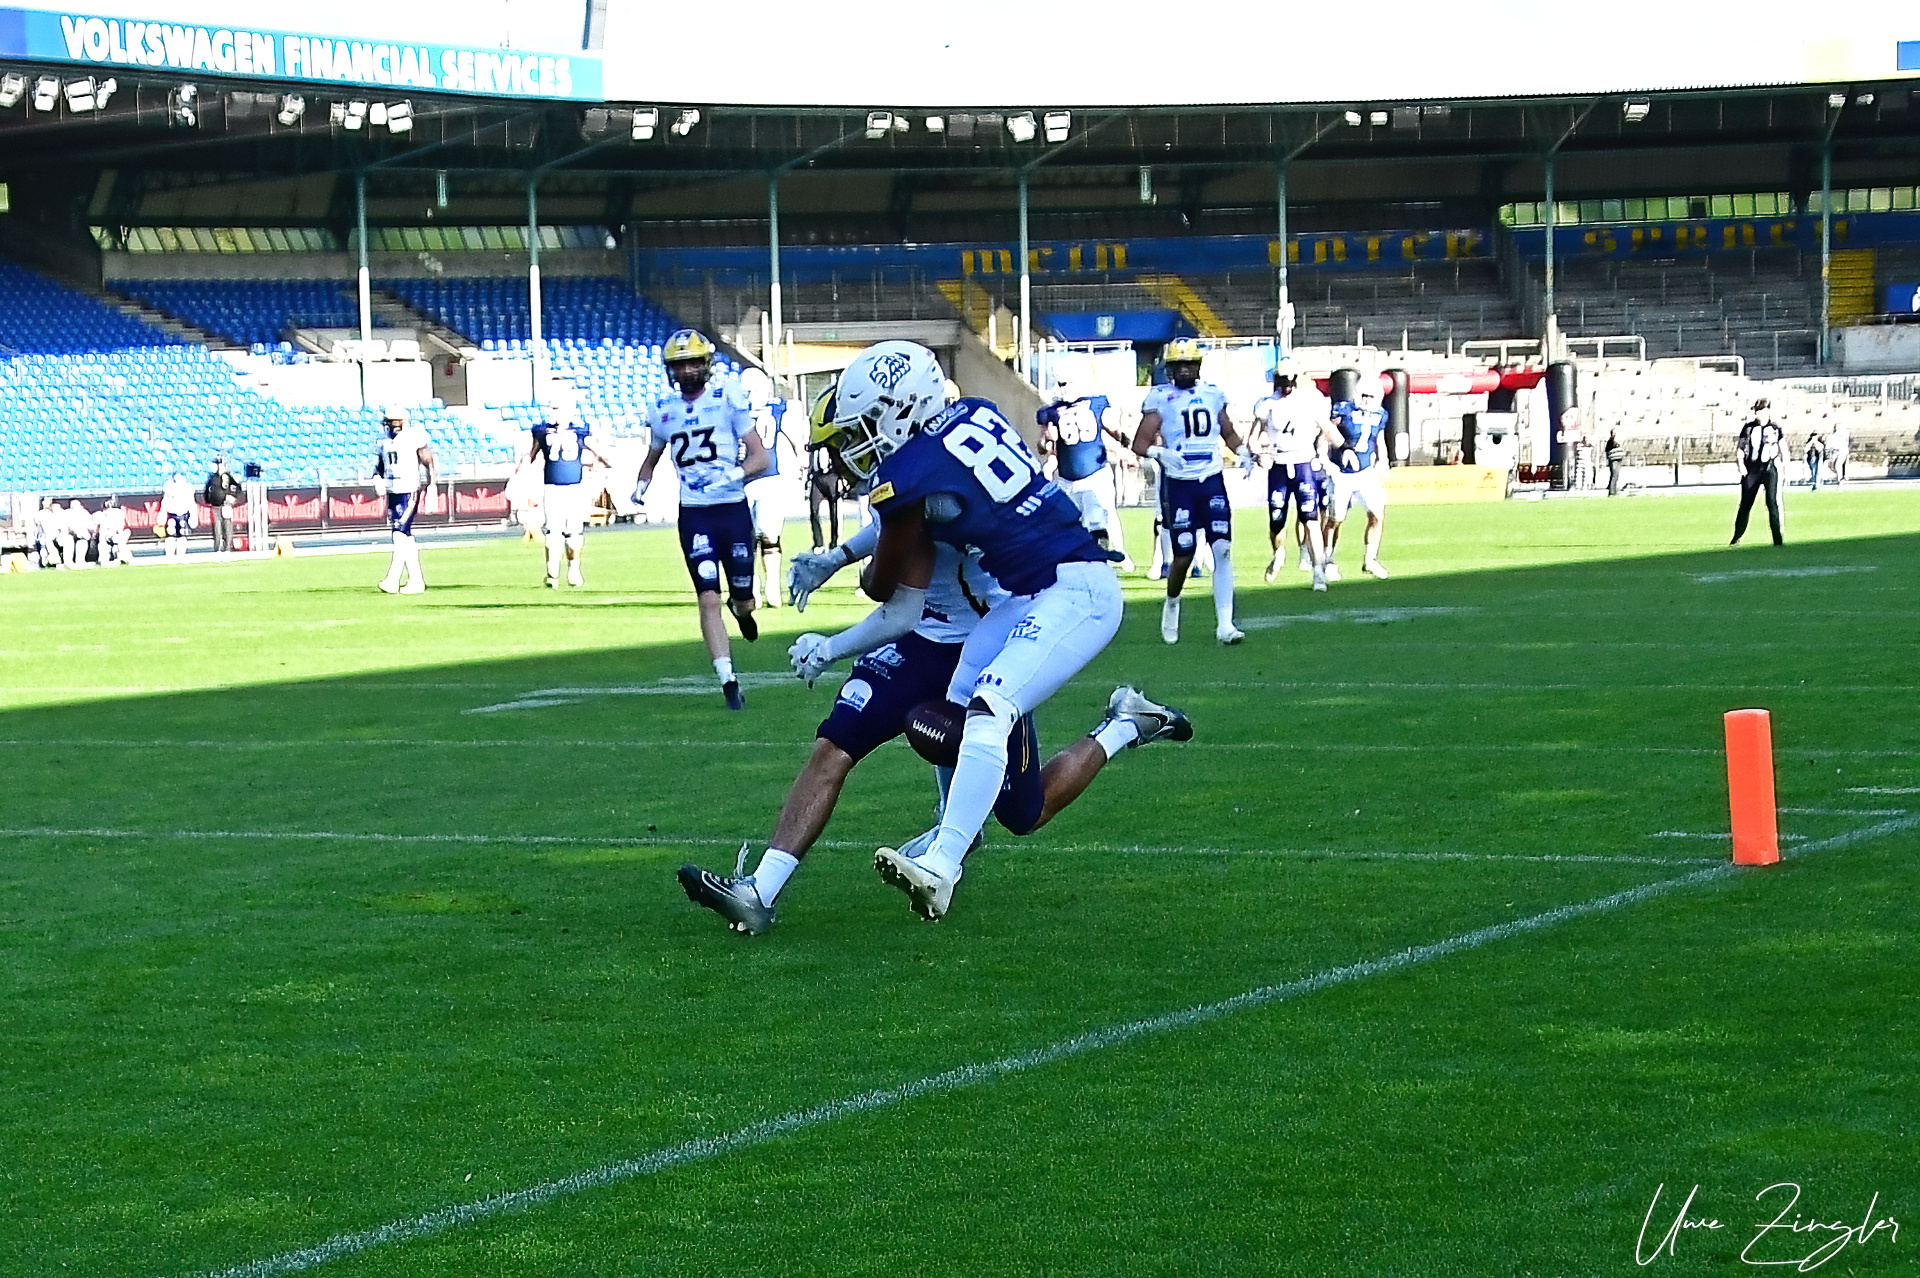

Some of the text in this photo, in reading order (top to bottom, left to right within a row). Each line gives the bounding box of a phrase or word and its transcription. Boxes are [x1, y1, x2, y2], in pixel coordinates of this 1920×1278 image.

[60, 15, 573, 97] VOLKSWAGEN FINANCIAL SERVICES
[1181, 408, 1211, 438] 10
[670, 426, 717, 468] 23
